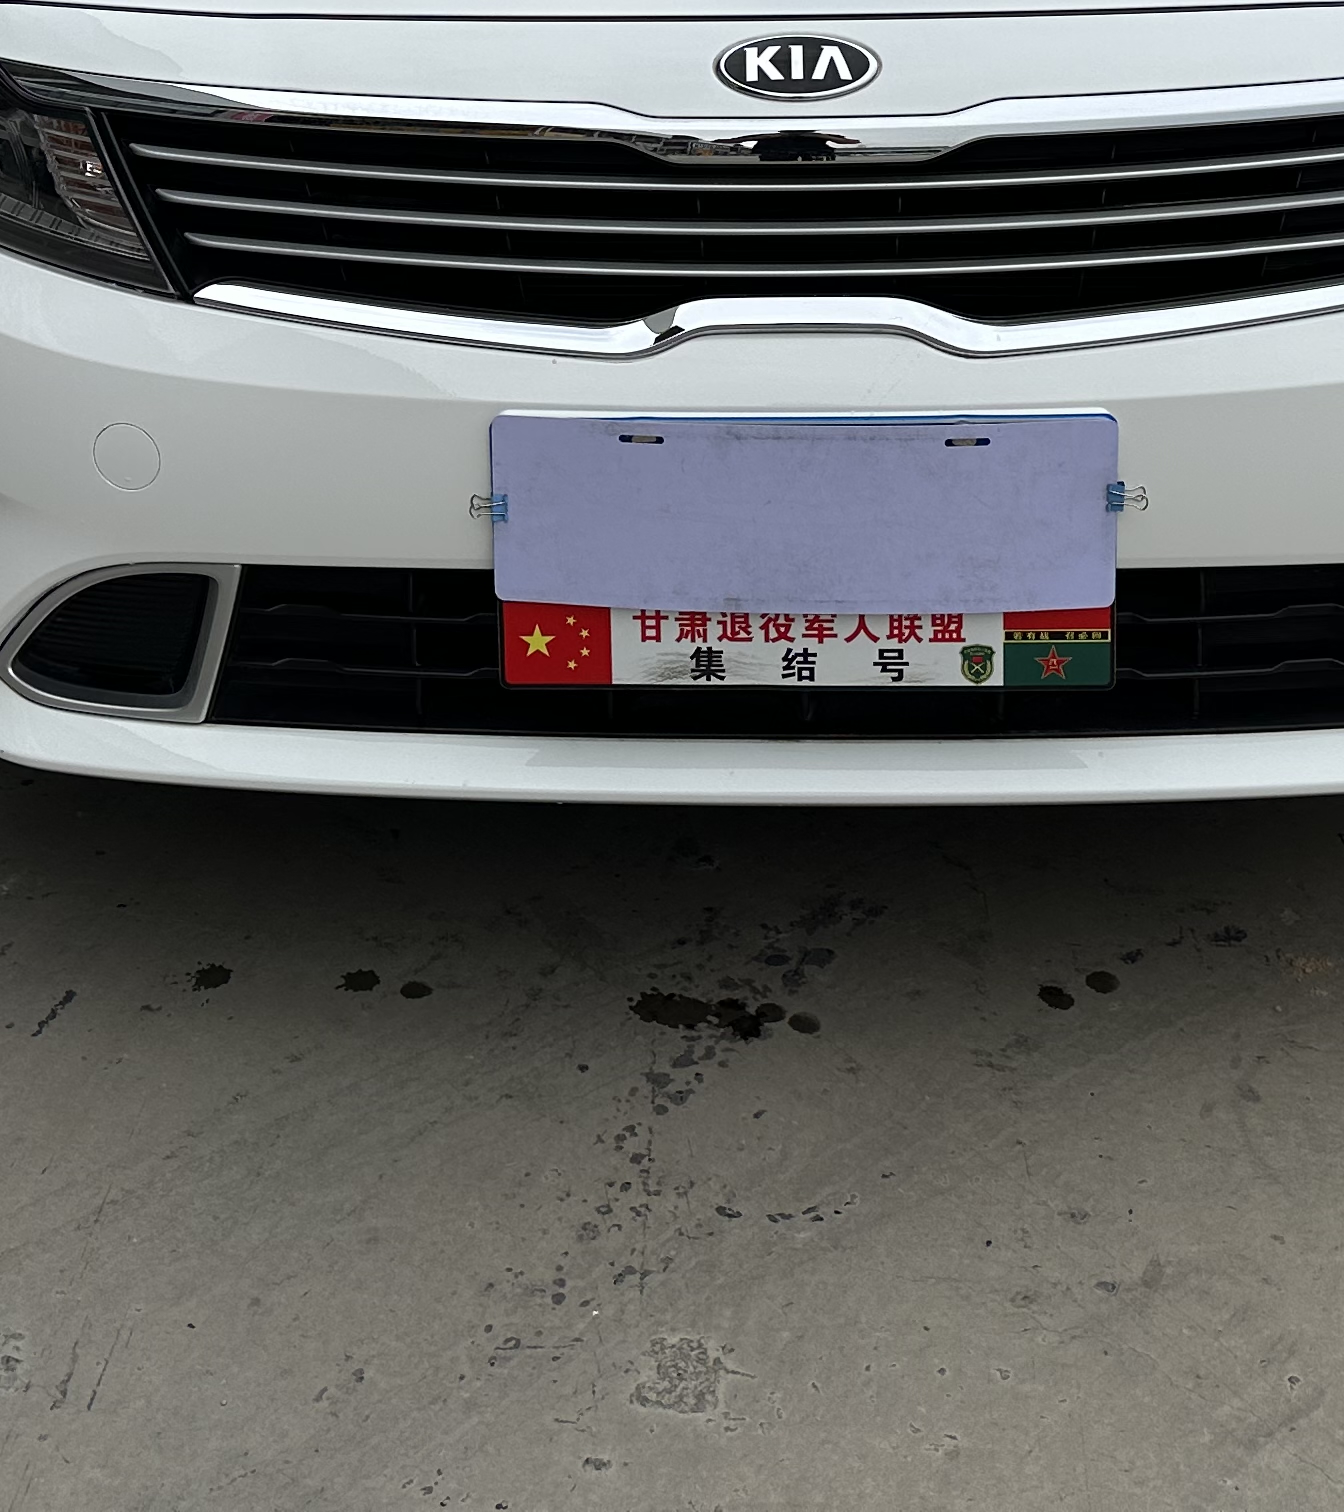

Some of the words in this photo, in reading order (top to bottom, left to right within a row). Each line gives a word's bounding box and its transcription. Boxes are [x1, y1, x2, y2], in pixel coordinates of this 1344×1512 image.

[743, 44, 853, 82] KIA
[632, 609, 967, 644] 甘肃退役军人联盟
[689, 646, 910, 683] 集结号
